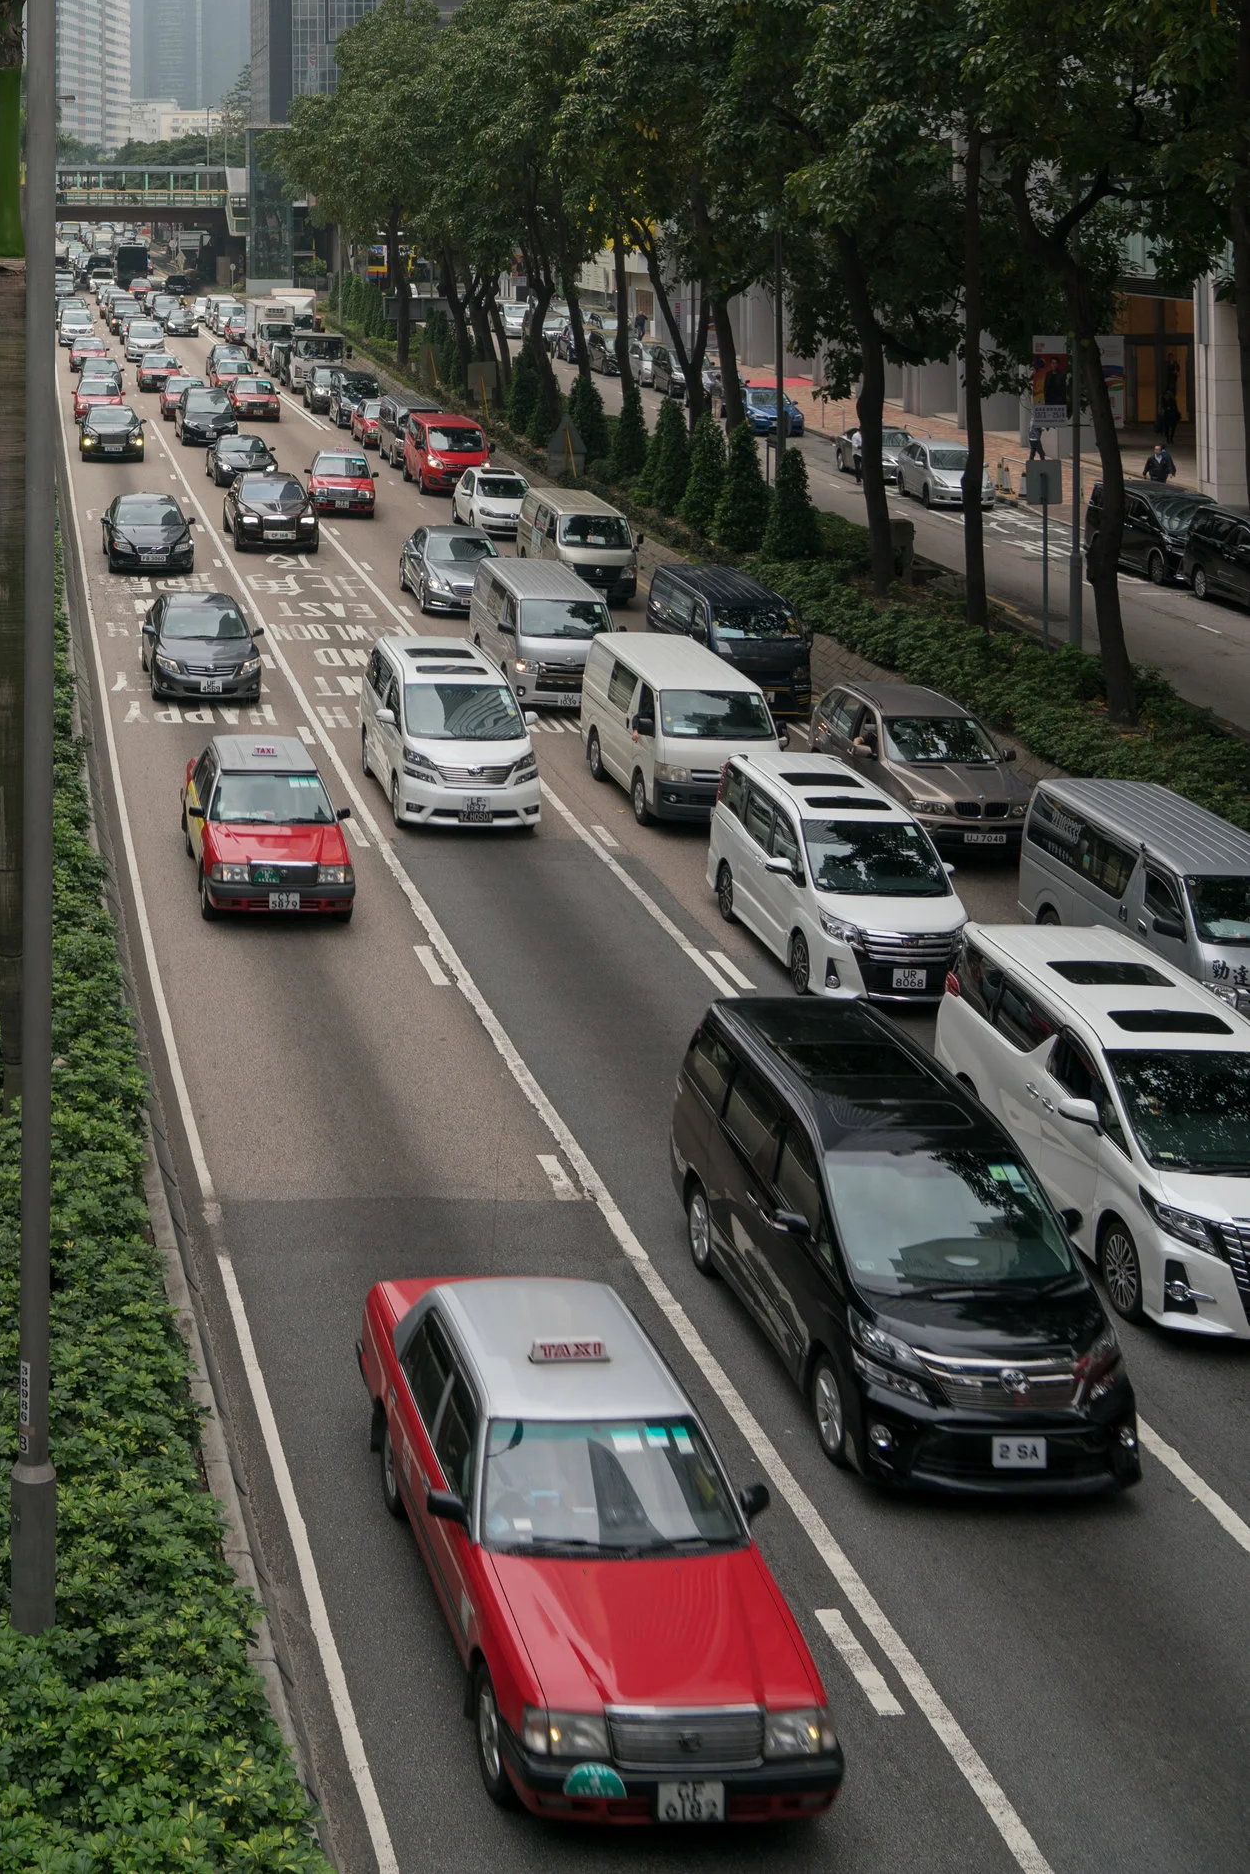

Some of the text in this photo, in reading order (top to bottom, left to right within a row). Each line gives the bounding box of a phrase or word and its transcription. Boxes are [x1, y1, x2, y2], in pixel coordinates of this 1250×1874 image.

[246, 574, 366, 597] 北角
[278, 601, 378, 619] EAST
[268, 623, 408, 641] KOWLOON
[313, 648, 370, 667] ND
[123, 701, 279, 726] HAPPY
[966, 834, 1004, 843] UJ 7048
[271, 899, 298, 909] 5879
[277, 891, 291, 900] CY
[895, 978, 924, 989] 8068
[902, 970, 918, 979] UR
[539, 1341, 603, 1359] TAXI
[20, 1366, 29, 1422] 38986
[999, 1443, 1040, 1460] 2 SA
